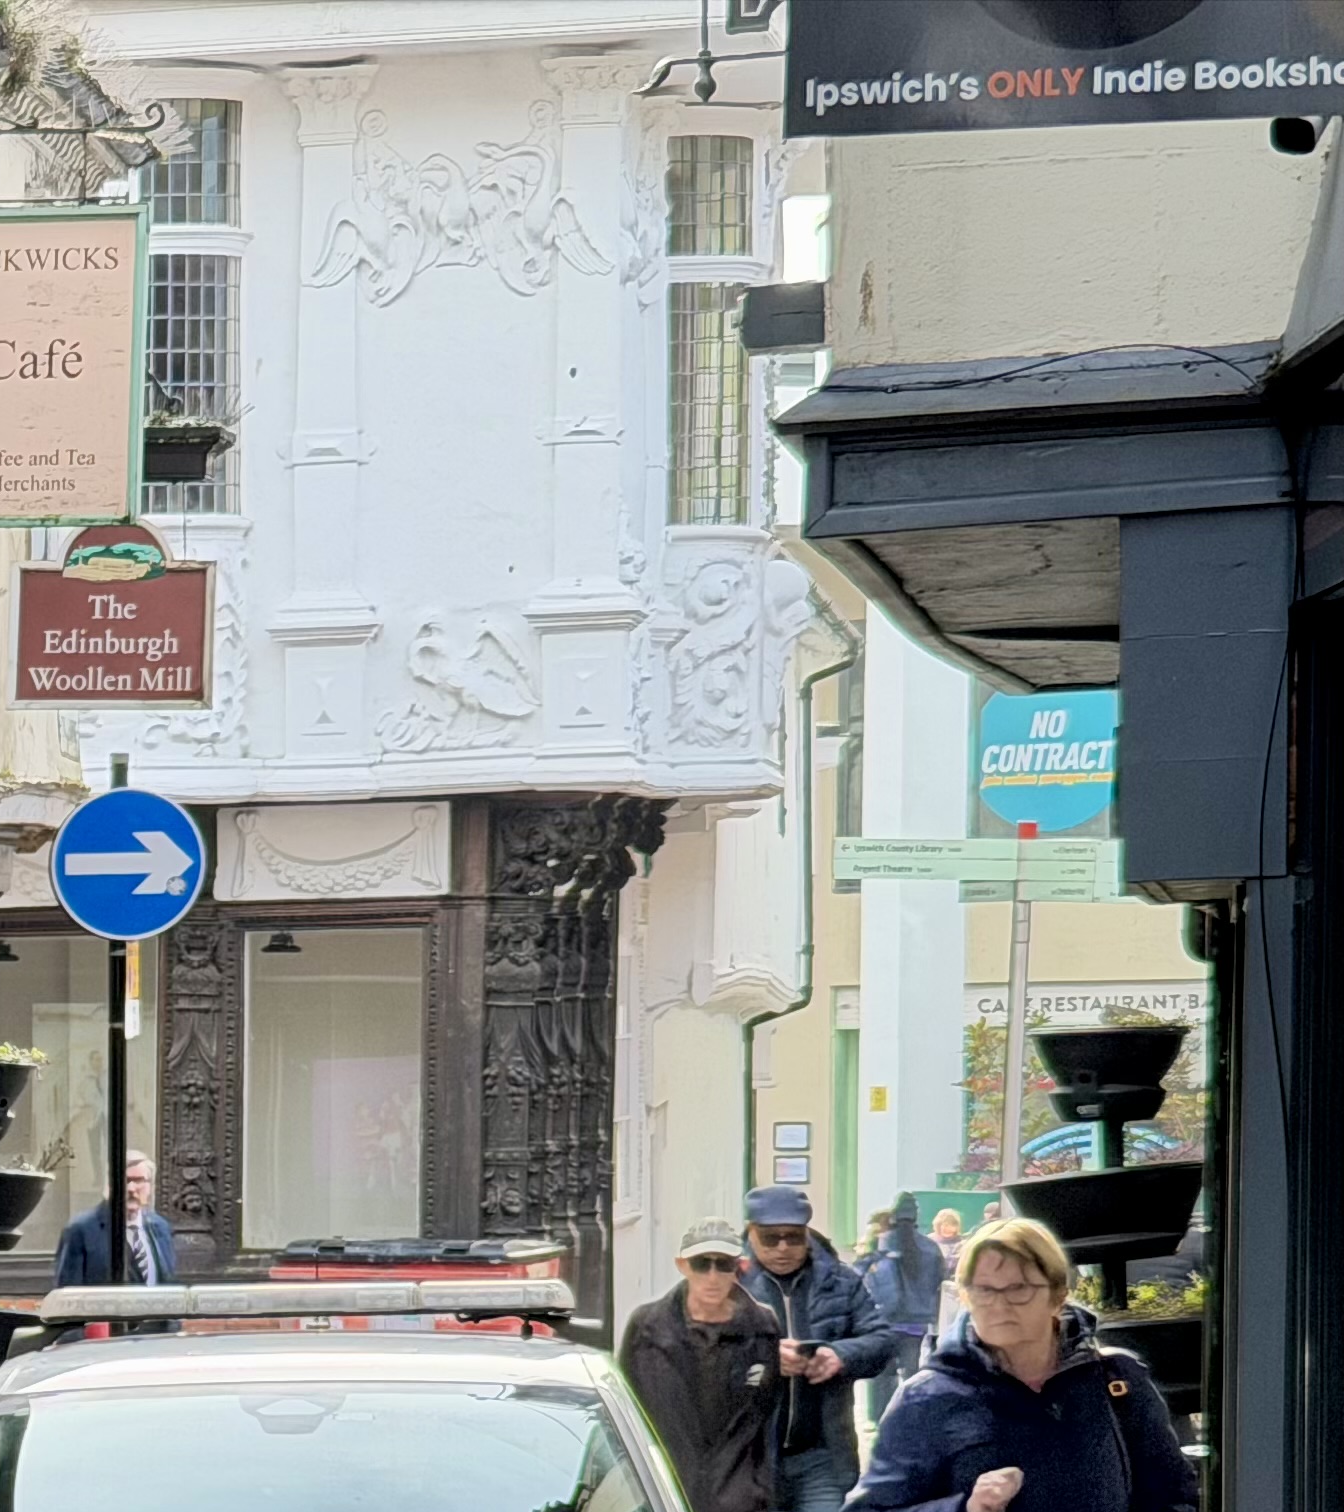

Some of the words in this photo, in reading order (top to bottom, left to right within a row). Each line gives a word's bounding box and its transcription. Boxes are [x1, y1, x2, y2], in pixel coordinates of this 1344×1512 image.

[805, 71, 980, 116] Ipswich's
[987, 66, 1085, 100] ONLY
[1093, 58, 1187, 96] Indie
[28, 449, 61, 469] and
[65, 449, 97, 468] Tea
[87, 593, 138, 621] The
[42, 629, 179, 662] Edinburgh
[28, 665, 132, 692] Woollen
[139, 665, 193, 692] Mill
[1029, 709, 1067, 739] NO
[981, 740, 1116, 774] CONTRACT
